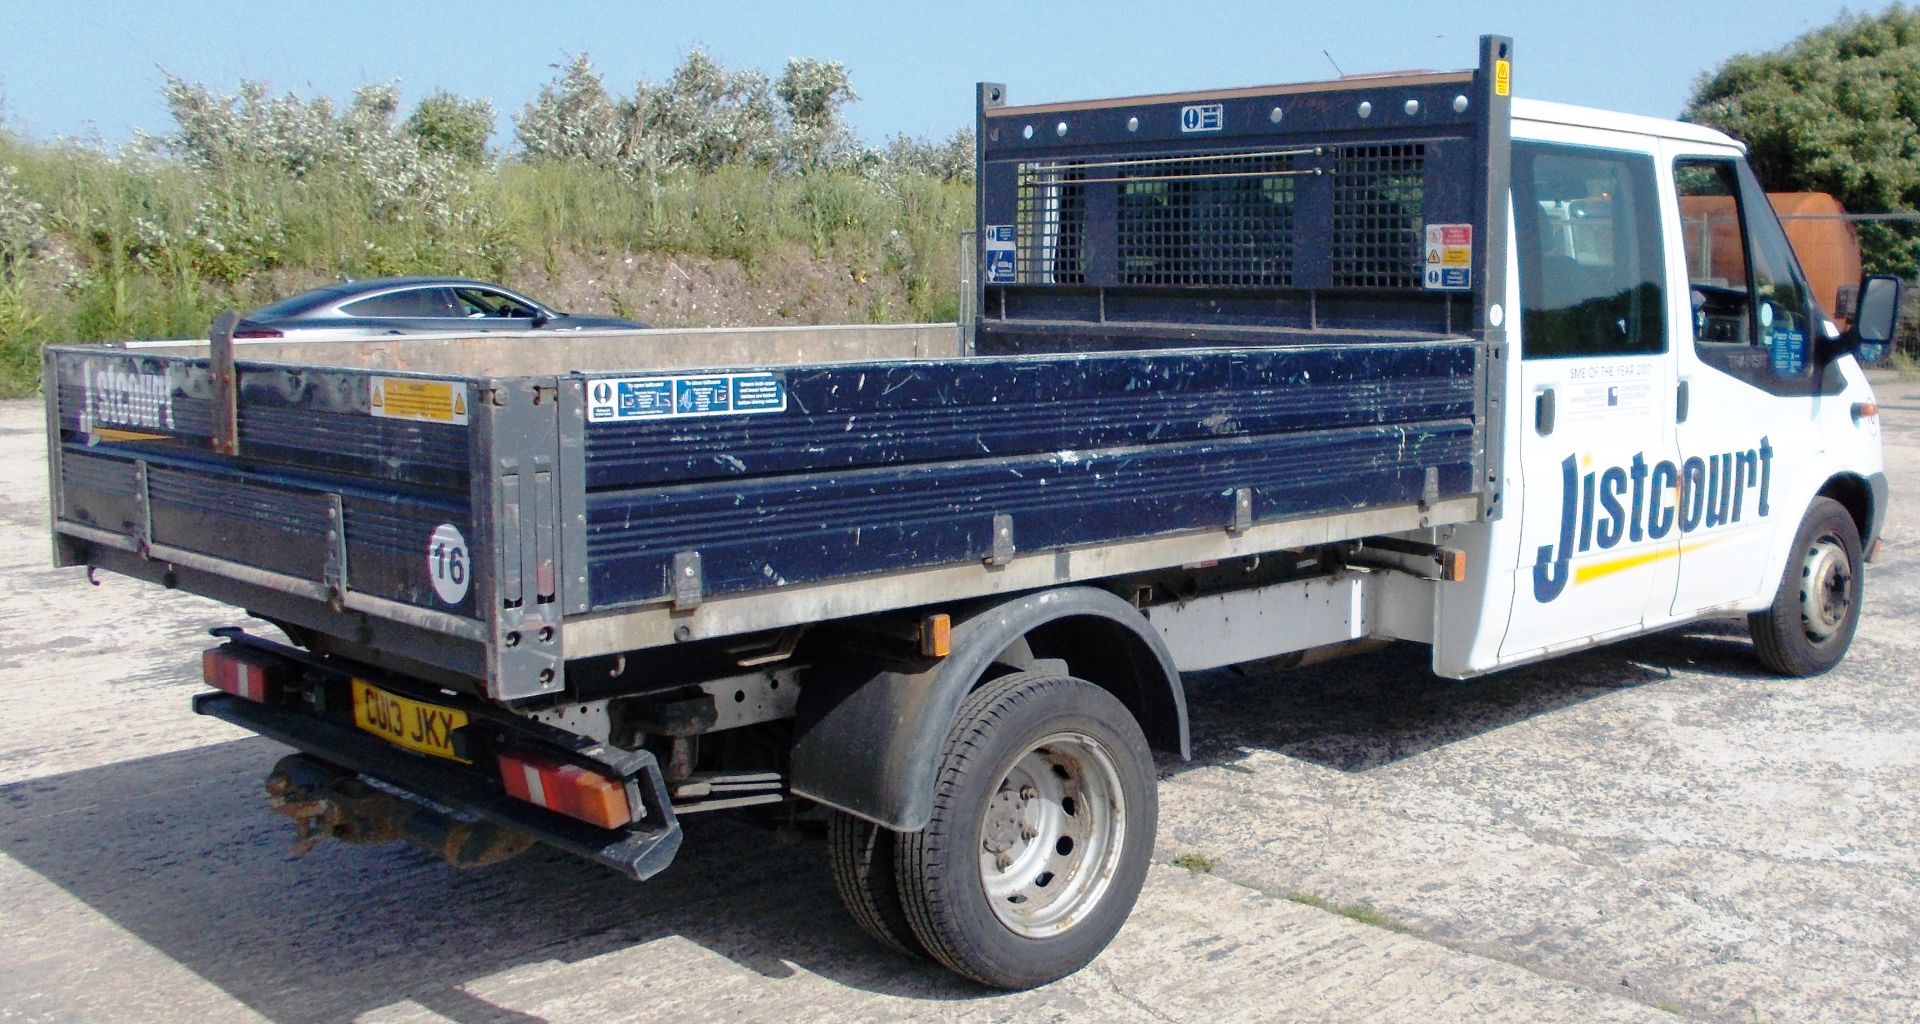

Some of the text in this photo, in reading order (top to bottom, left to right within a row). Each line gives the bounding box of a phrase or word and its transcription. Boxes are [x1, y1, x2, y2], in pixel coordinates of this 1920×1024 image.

[1570, 367, 1586, 380] SME
[1588, 366, 1599, 378] OF
[1601, 365, 1614, 377] THE
[1616, 364, 1634, 377] YEAR
[1533, 435, 1773, 603] Jistcourt
[434, 543, 465, 585] 16
[365, 687, 404, 738] CU13
